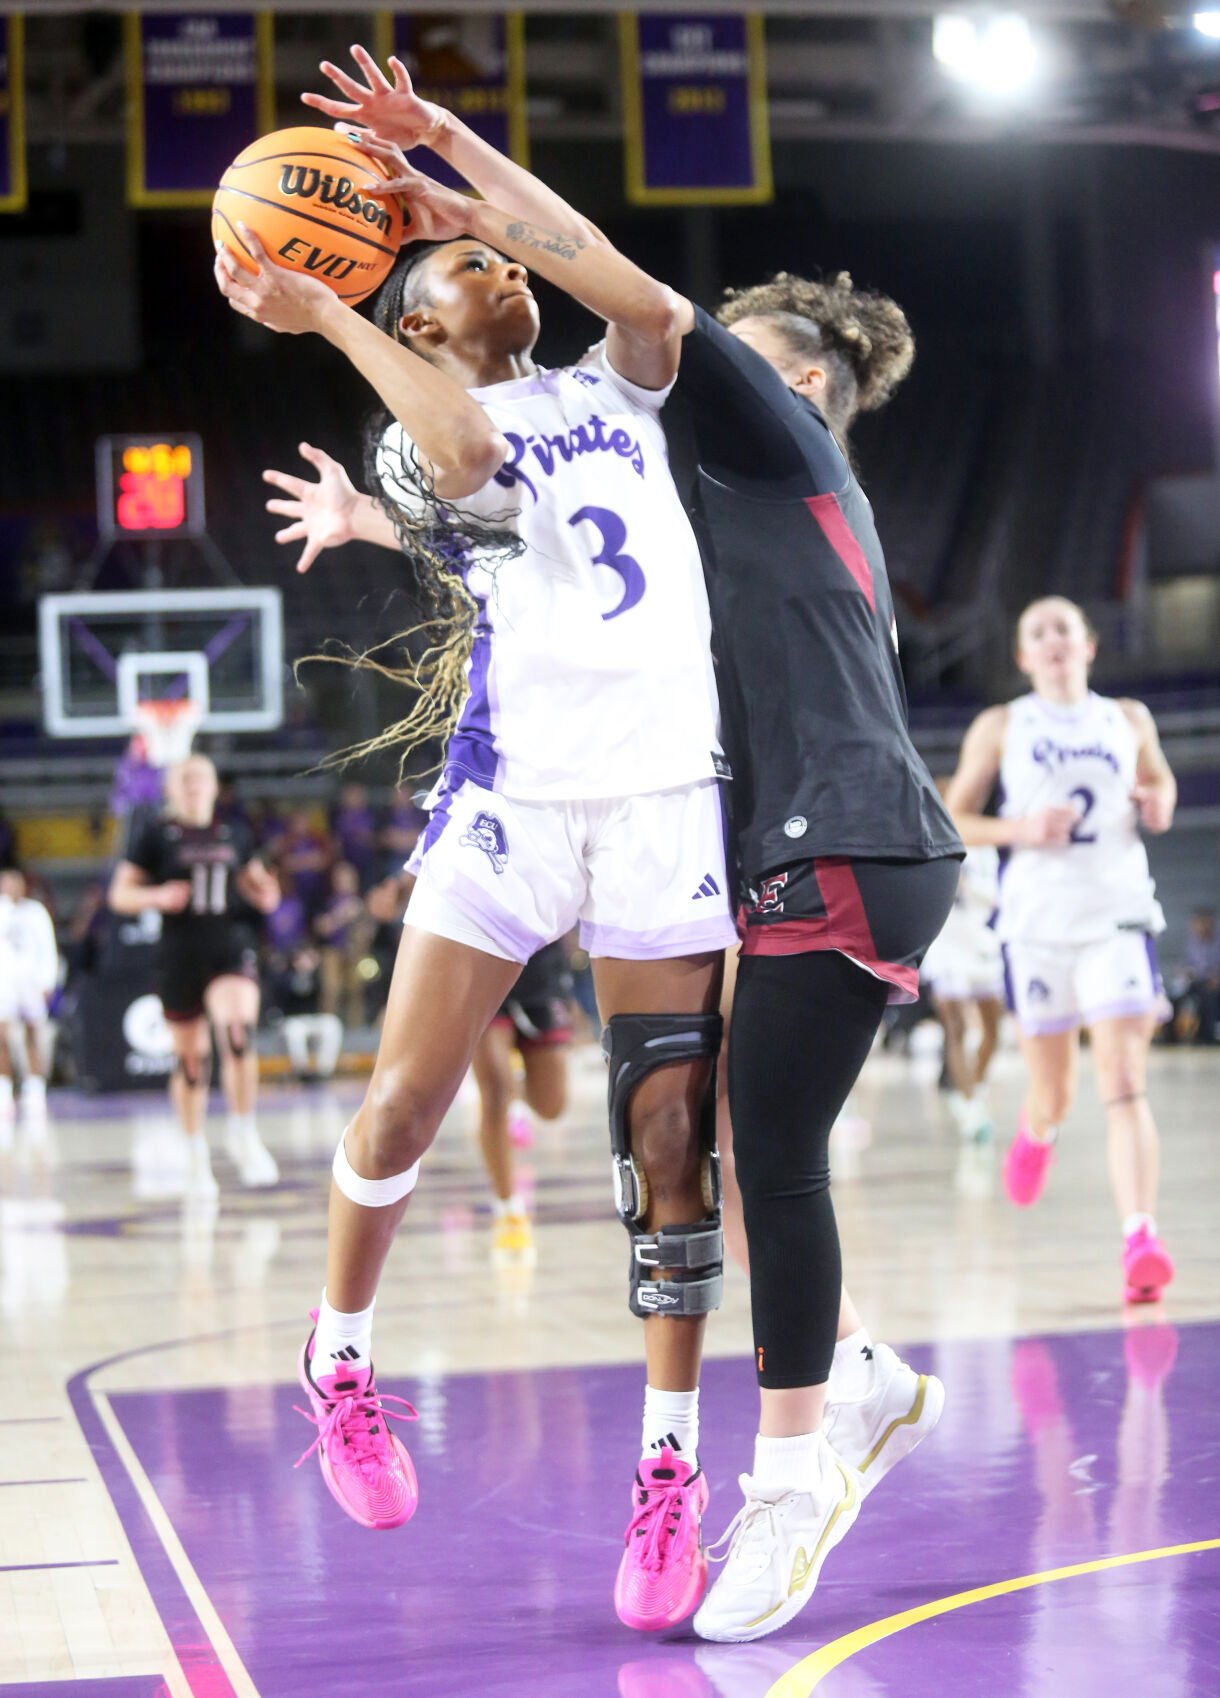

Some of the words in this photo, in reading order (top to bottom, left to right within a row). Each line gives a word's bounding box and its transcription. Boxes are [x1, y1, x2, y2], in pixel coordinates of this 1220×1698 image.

[279, 164, 393, 237] Wilson
[278, 237, 358, 280] EVO
[493, 414, 646, 503] Pirates
[569, 505, 646, 622] 3
[479, 818, 499, 831] ECU
[1069, 786, 1097, 844] 2
[191, 863, 227, 915] 11
